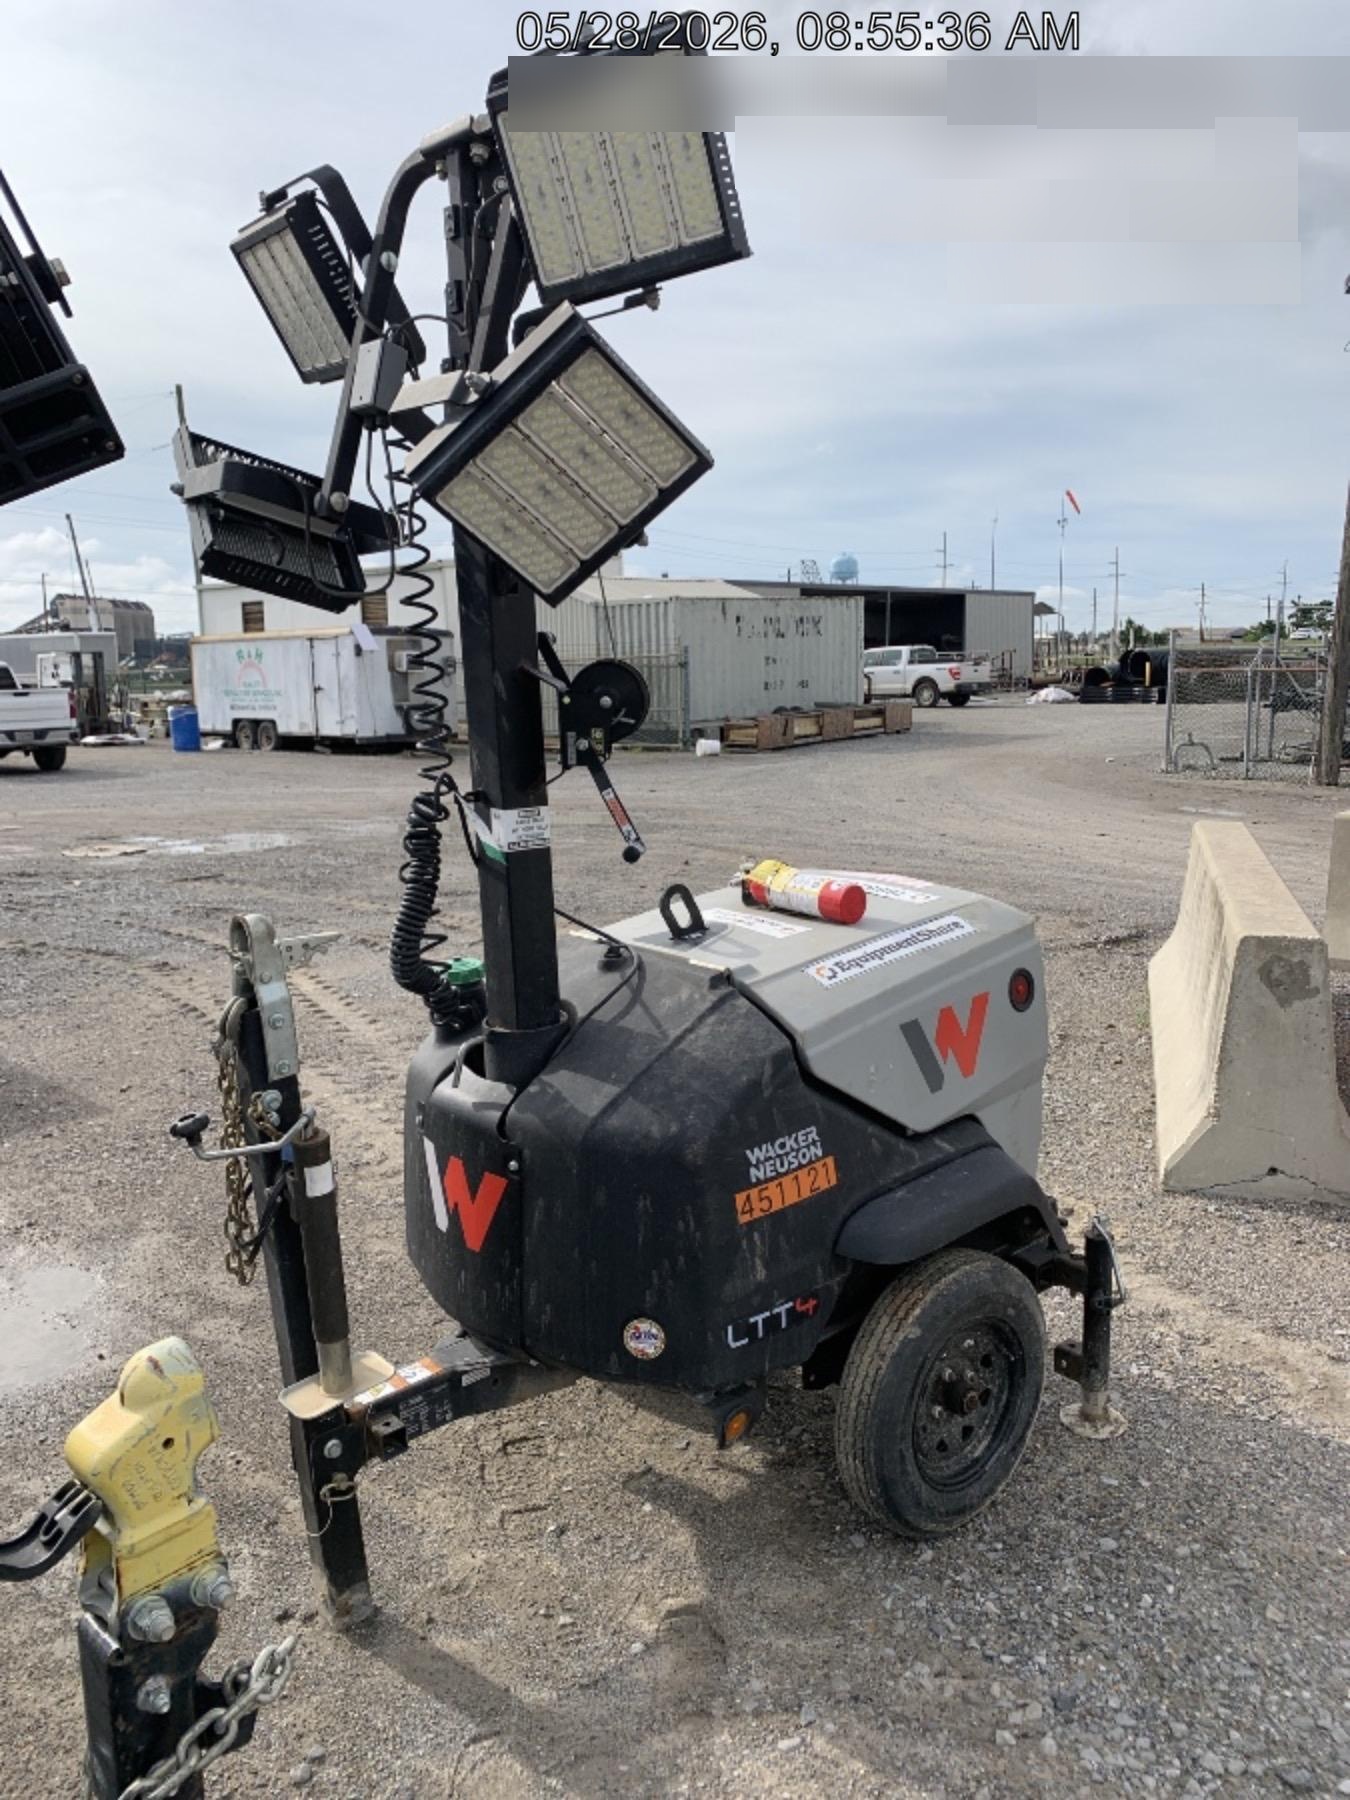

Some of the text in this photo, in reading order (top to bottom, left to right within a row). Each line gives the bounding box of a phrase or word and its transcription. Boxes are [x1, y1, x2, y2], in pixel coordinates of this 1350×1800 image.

[836, 920, 966, 973] EquipmentShare
[745, 1125, 820, 1164] WACKER
[749, 1141, 823, 1183] NEUSON
[740, 1161, 832, 1218] 451121
[726, 1295, 819, 1350] LTT4
